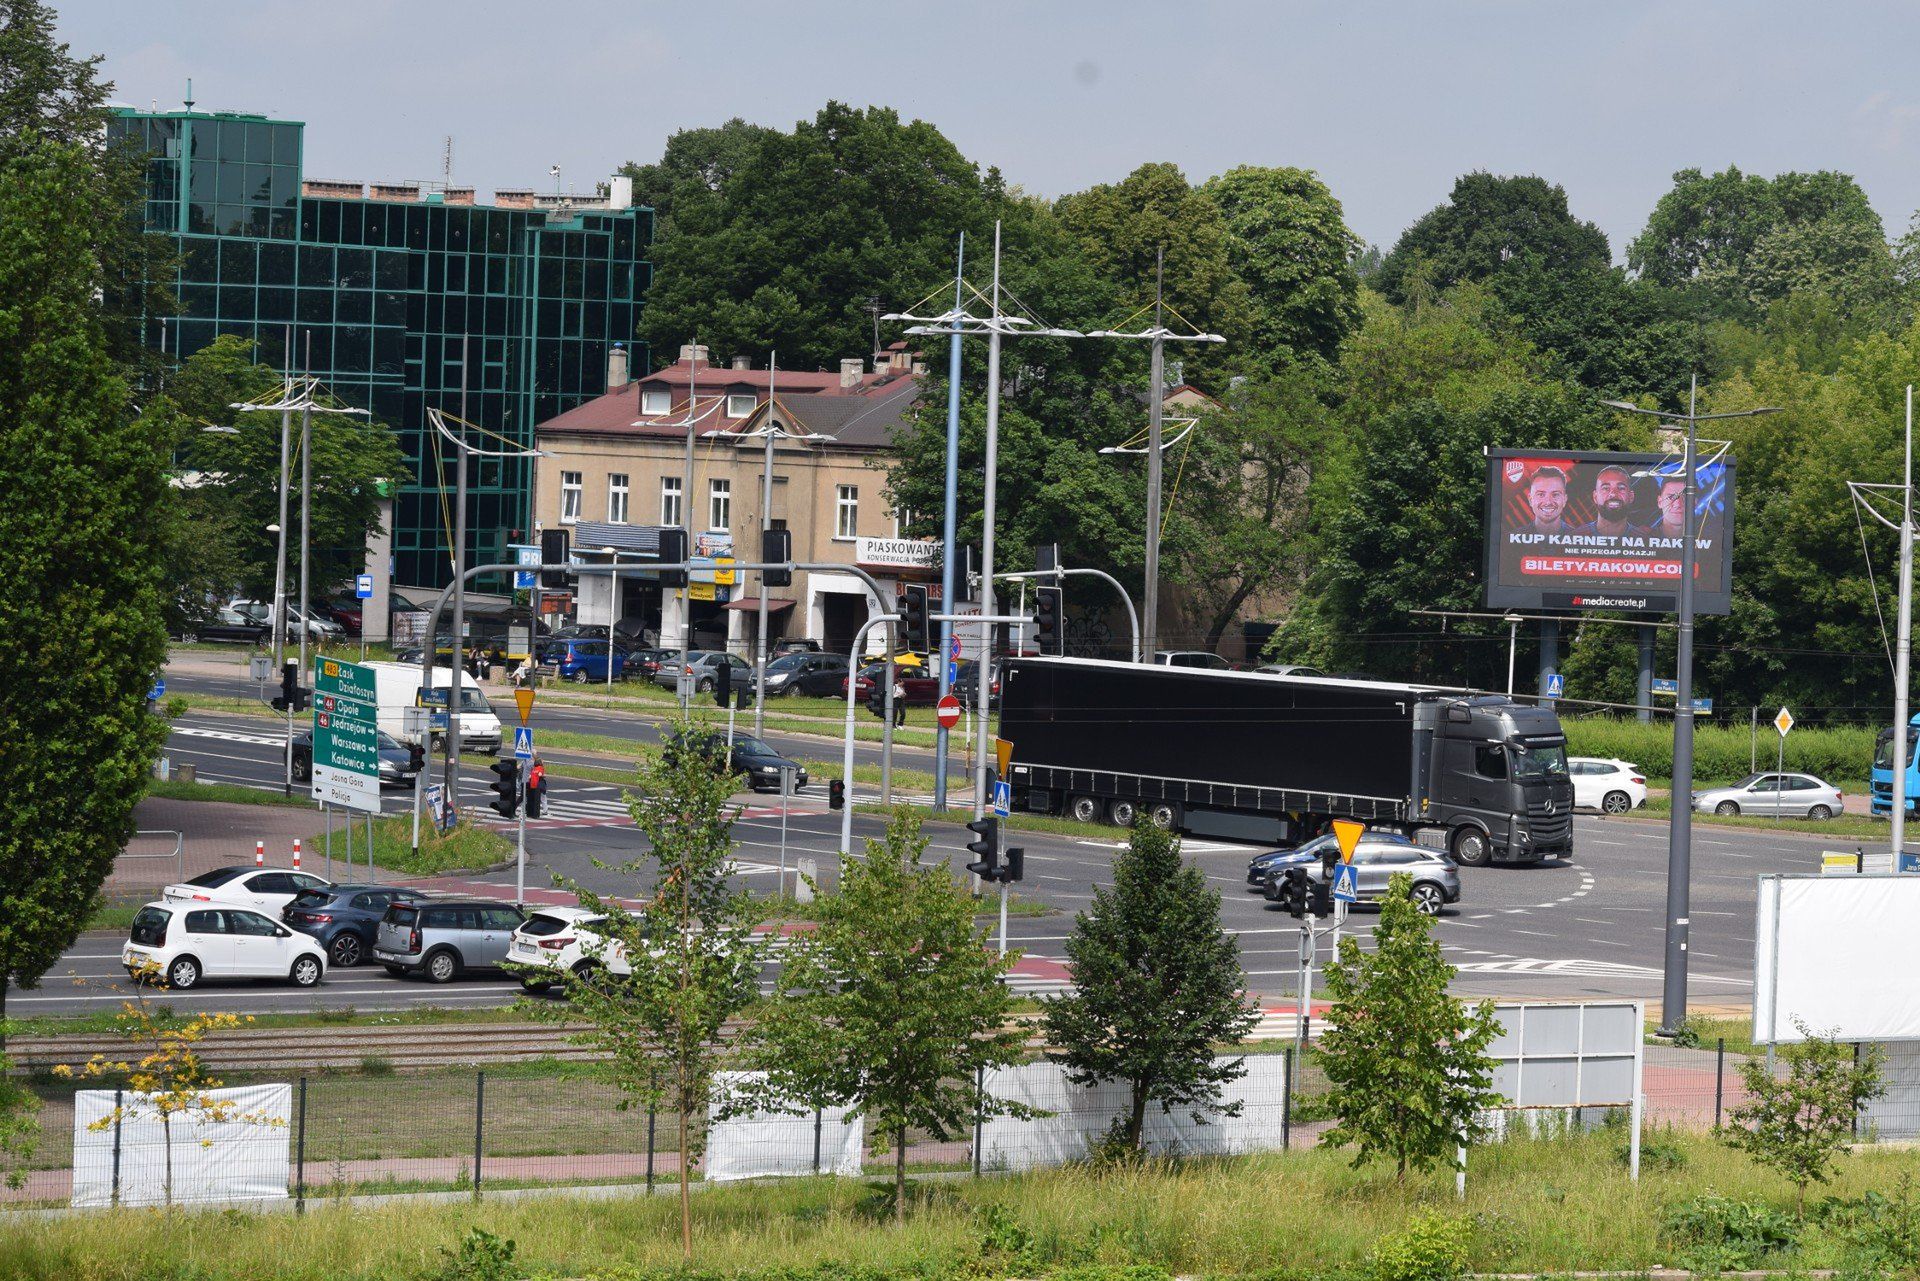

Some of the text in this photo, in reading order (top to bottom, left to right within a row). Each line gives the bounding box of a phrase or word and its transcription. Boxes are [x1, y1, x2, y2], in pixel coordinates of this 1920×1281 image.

[1509, 533, 1712, 549] KUP KARNET NA RAKW
[867, 554, 910, 563] KONSERWACJA
[1581, 548, 1621, 556] PRZEGAP
[1525, 560, 1682, 575] BILETY.RAKOW.CO
[1582, 595, 1646, 609] mediacreate.pl
[338, 665, 354, 680] Łask
[338, 680, 375, 700] Działoszyn
[337, 700, 359, 716] Opole
[331, 716, 367, 735] Jędrzejów
[331, 734, 367, 753] Warszawa
[331, 751, 365, 770] Katowice
[331, 772, 348, 784] Jasna
[331, 788, 351, 803] Policja
